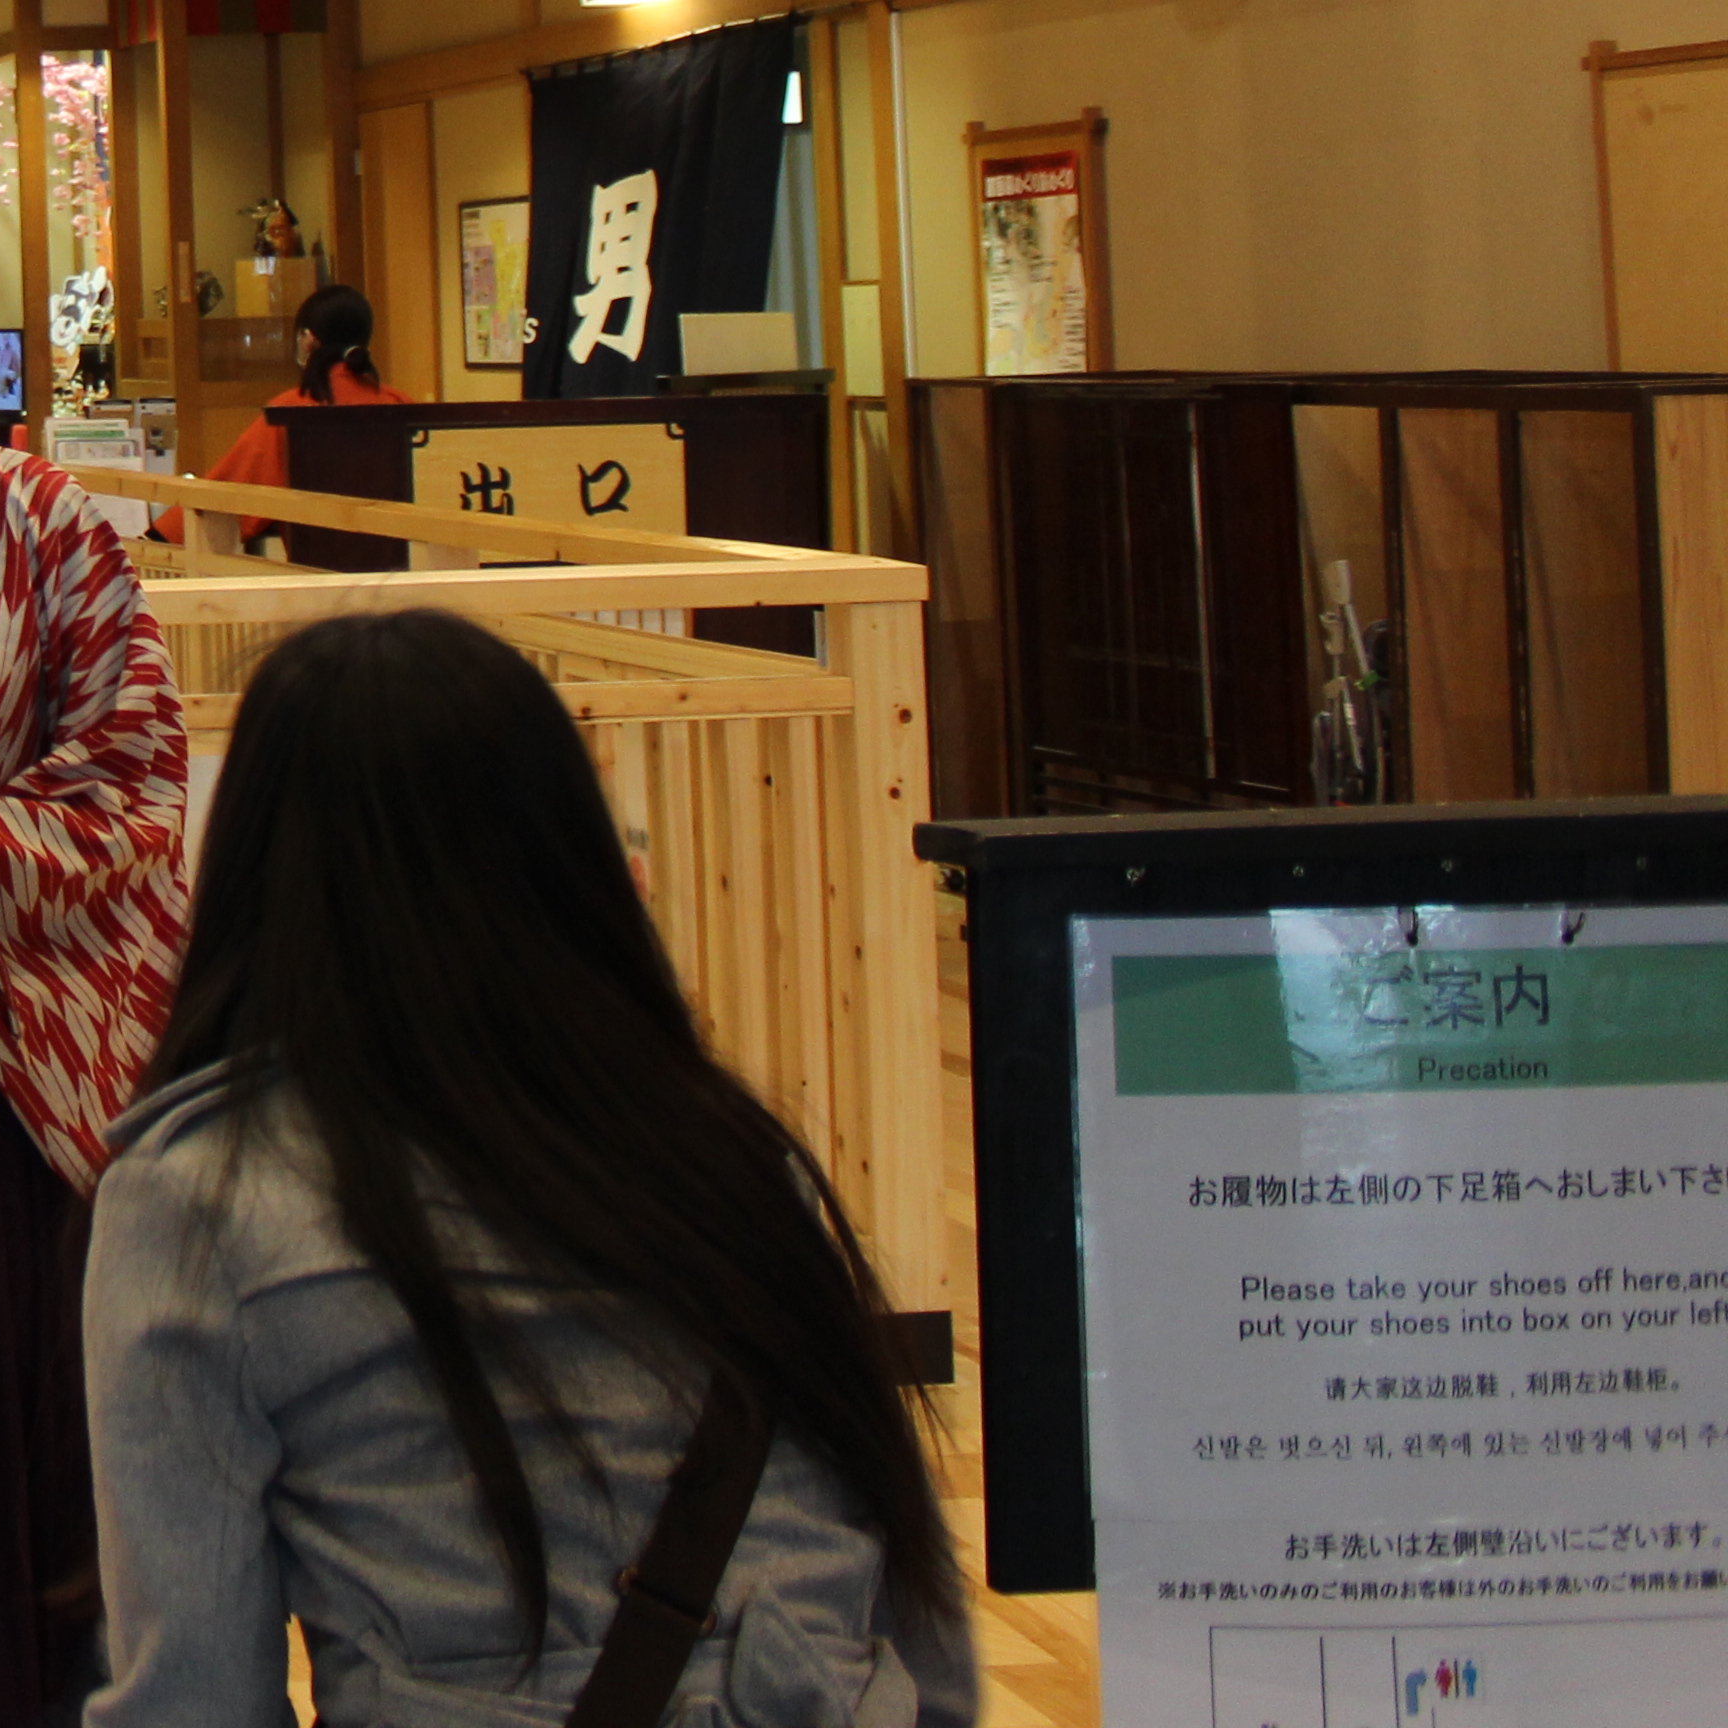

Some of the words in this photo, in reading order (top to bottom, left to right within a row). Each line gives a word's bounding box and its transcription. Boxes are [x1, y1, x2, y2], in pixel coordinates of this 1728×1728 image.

[568, 169, 658, 365] 男
[460, 460, 631, 515] 出口
[1417, 1056, 1549, 1082] Precation
[1188, 1163, 1728, 1209] お履物は左側の下足箱へおしまい下さ
[1241, 1275, 1335, 1303] Please
[1348, 1275, 1405, 1301] take
[1418, 1275, 1478, 1305] your
[1489, 1271, 1567, 1298] shoes
[1577, 1268, 1614, 1295] off
[1238, 1314, 1285, 1341] put
[1296, 1317, 1358, 1342] your
[1370, 1310, 1450, 1336] shoes
[1461, 1309, 1512, 1334] into
[1523, 1307, 1570, 1333] box
[1580, 1310, 1611, 1331] on
[1622, 1307, 1680, 1332] your
[1193, 1434, 1267, 1462] 신발은
[1279, 1434, 1353, 1460] 벗으신
[1403, 1432, 1473, 1458] 왼쪽에
[1485, 1431, 1530, 1457] 있는
[1698, 1422, 1728, 1448] 주
